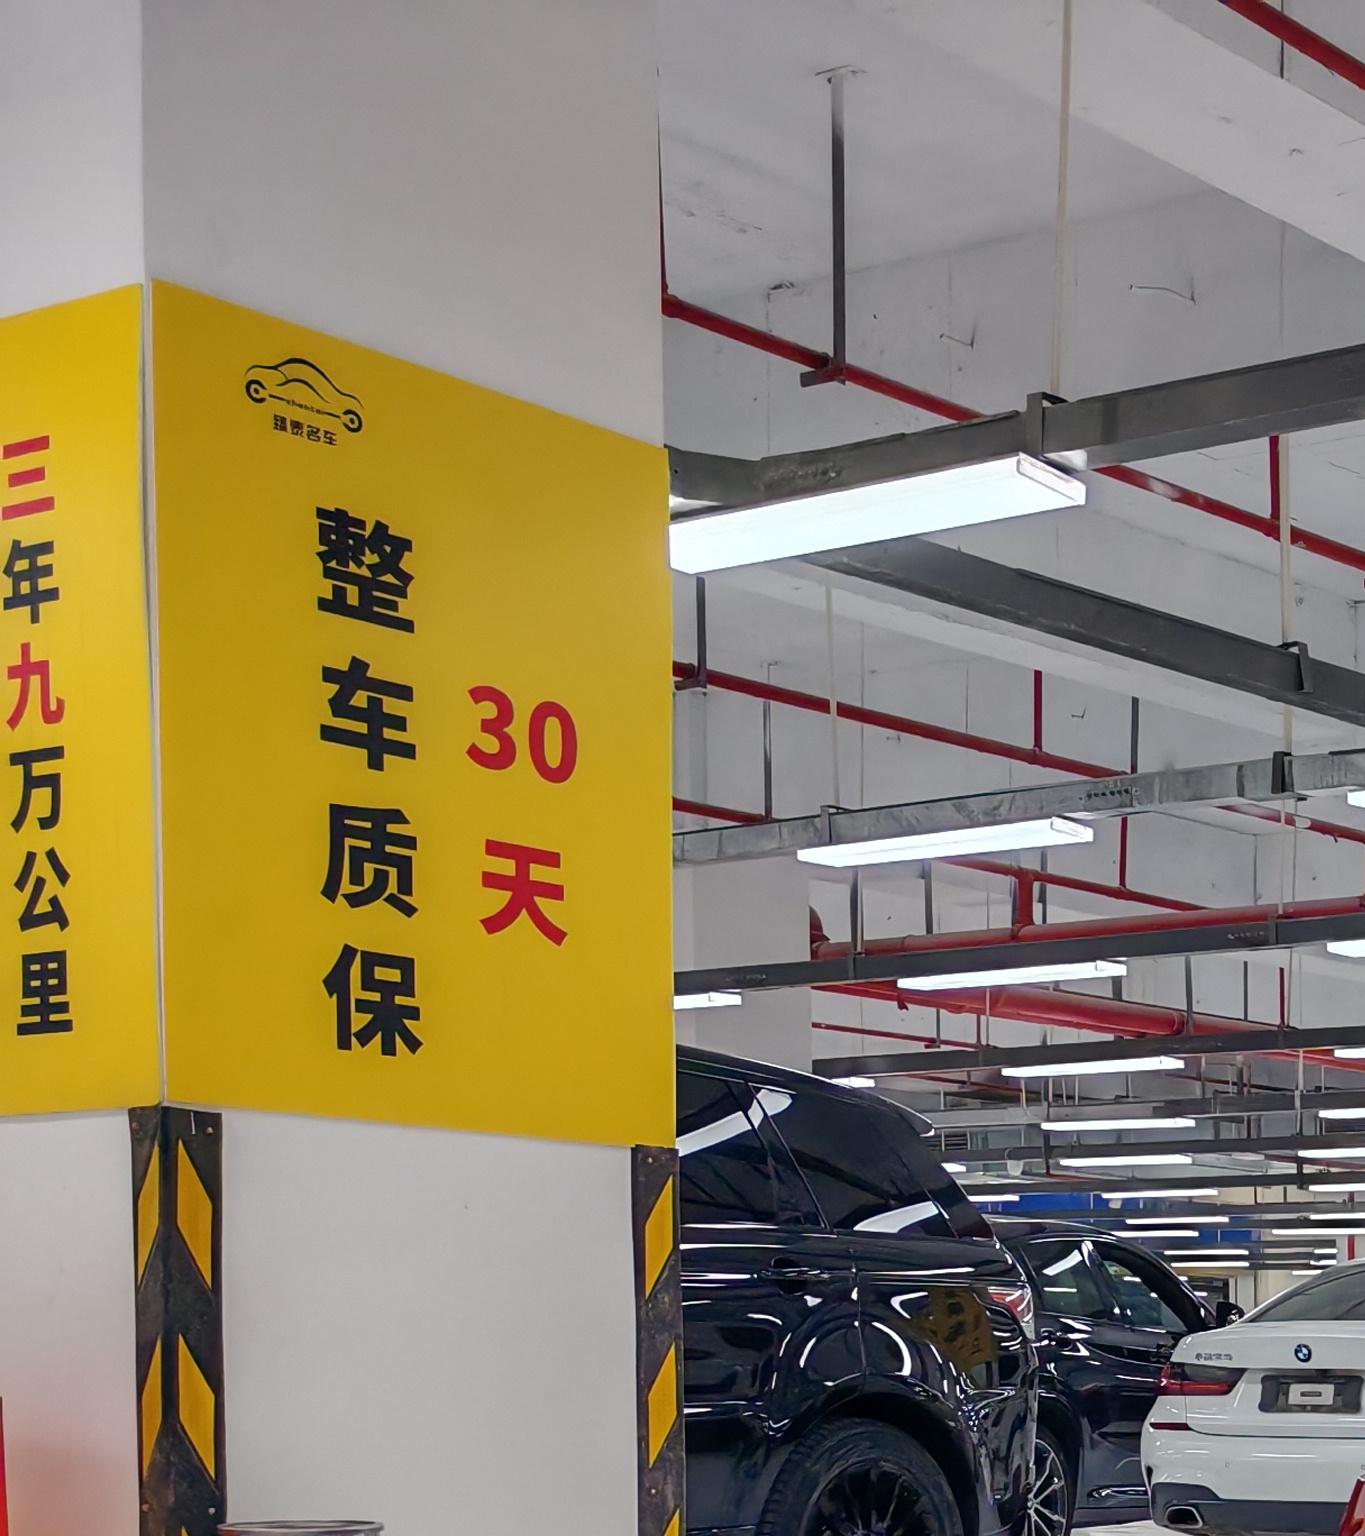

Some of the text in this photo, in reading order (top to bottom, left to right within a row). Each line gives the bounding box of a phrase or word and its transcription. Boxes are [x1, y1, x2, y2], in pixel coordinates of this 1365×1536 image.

[1, 435, 74, 1036] 三年九万公里
[315, 506, 424, 1058] 整车质保
